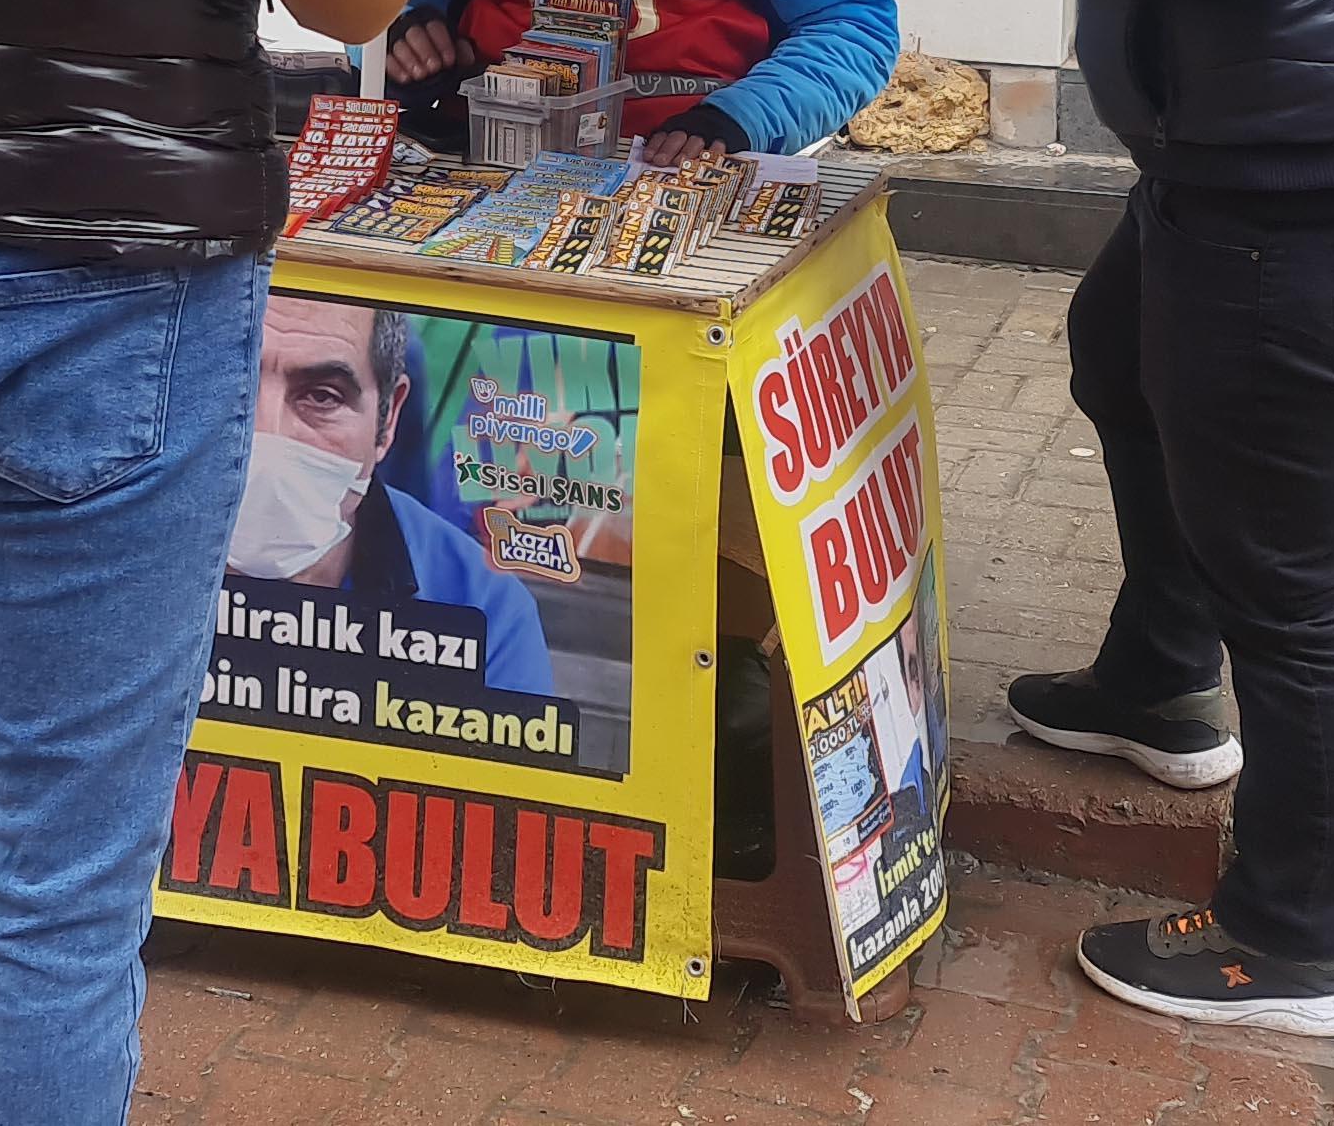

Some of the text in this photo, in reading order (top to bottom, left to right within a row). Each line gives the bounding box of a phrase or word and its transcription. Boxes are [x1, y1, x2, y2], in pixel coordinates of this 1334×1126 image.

[320, 154, 379, 167] KATLA
[332, 132, 389, 147] KATLA
[758, 271, 914, 494] SÜREYYA
[470, 413, 572, 452] piyango
[494, 395, 546, 422] milli
[481, 464, 623, 513] Sisal ŞANS
[509, 526, 555, 553] kazı
[810, 421, 926, 644] BULUT
[378, 611, 480, 670] kazı
[277, 667, 361, 725] lira
[375, 680, 574, 757] kazandı
[308, 778, 654, 951] BULUT
